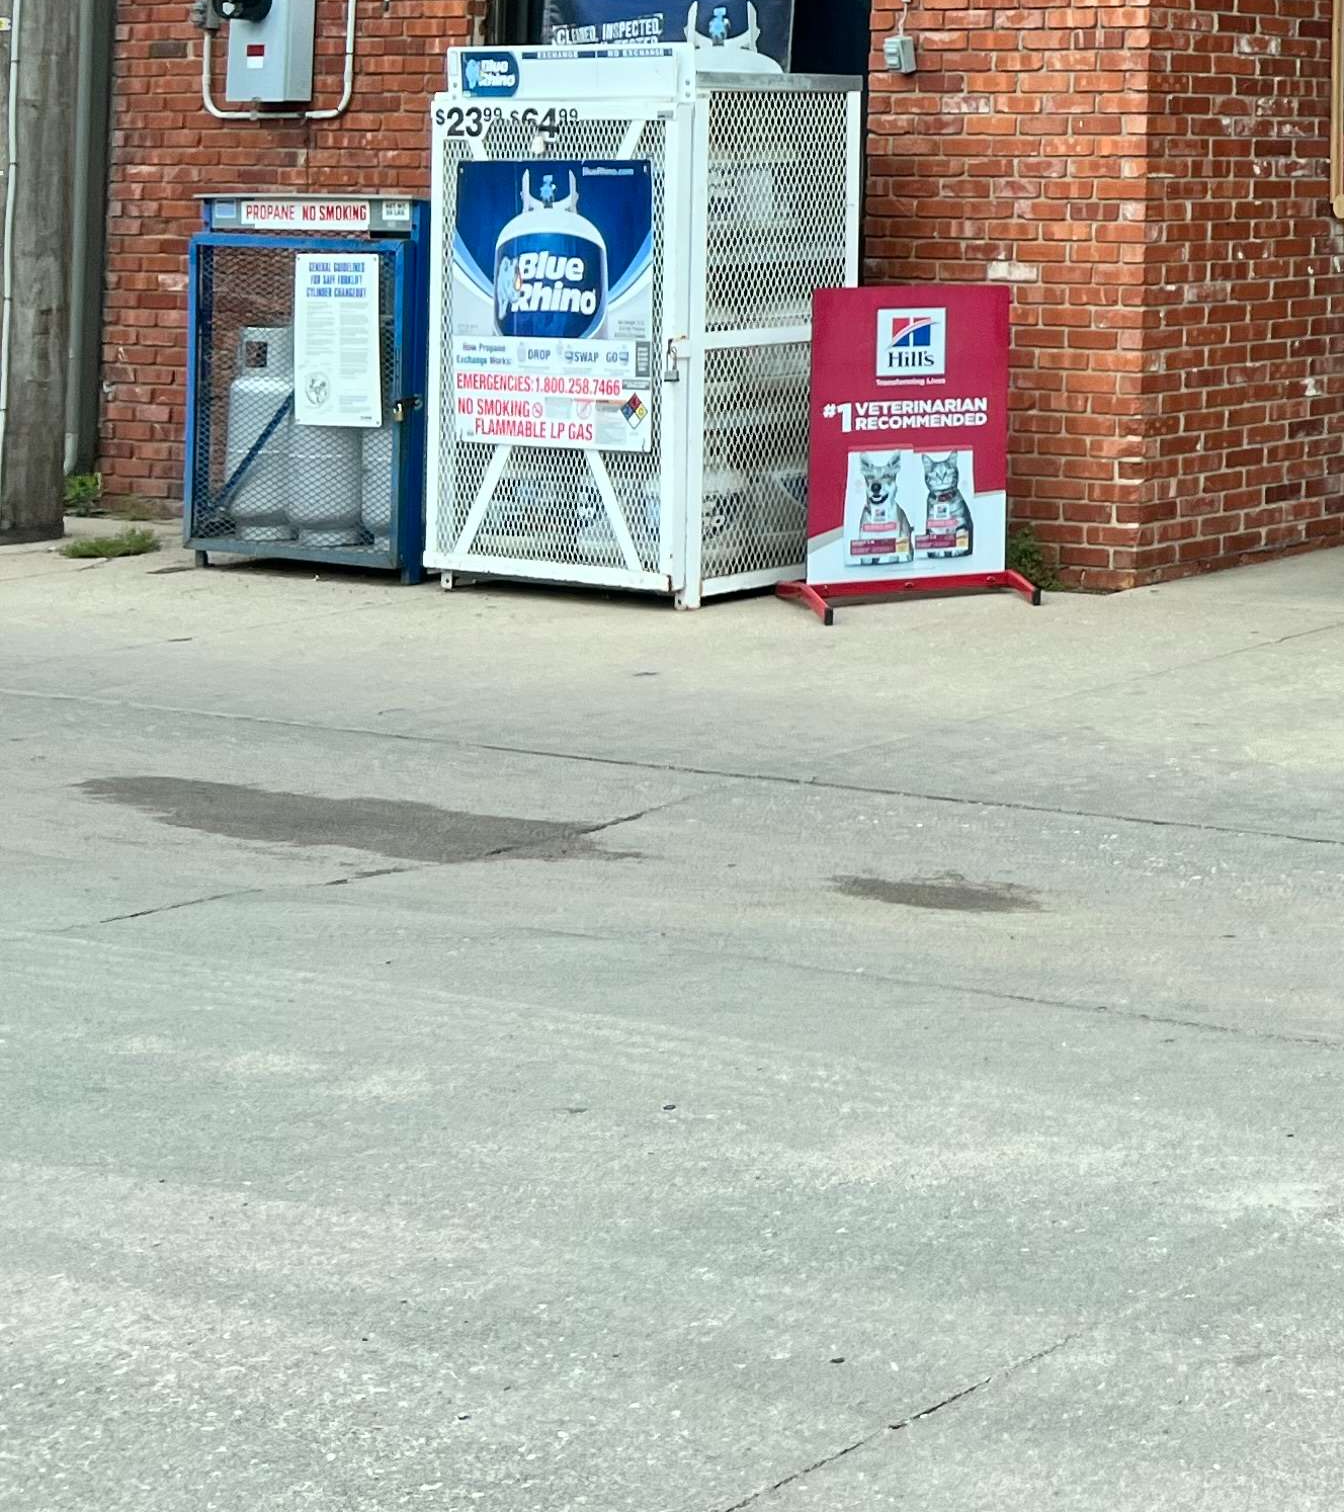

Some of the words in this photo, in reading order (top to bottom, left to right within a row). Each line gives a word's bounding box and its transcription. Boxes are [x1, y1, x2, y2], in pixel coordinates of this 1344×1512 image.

[246, 204, 295, 220] PROPANE
[302, 205, 316, 221] NO
[319, 205, 367, 221] SMOKING
[518, 251, 584, 281] Blue
[511, 281, 597, 315] Rhino
[527, 348, 550, 360] DROP
[574, 350, 599, 363] SWAP
[605, 351, 618, 362] GO
[888, 350, 935, 368] Hill's
[458, 397, 473, 414] NO
[477, 399, 530, 418] SMOKING
[823, 403, 852, 433] #1
[855, 397, 988, 416] VETERINARIAN
[475, 418, 546, 439] FLAMMABLE
[550, 422, 565, 439] LP
[568, 423, 593, 441] GAS
[855, 413, 988, 431] RECOMMENDED
